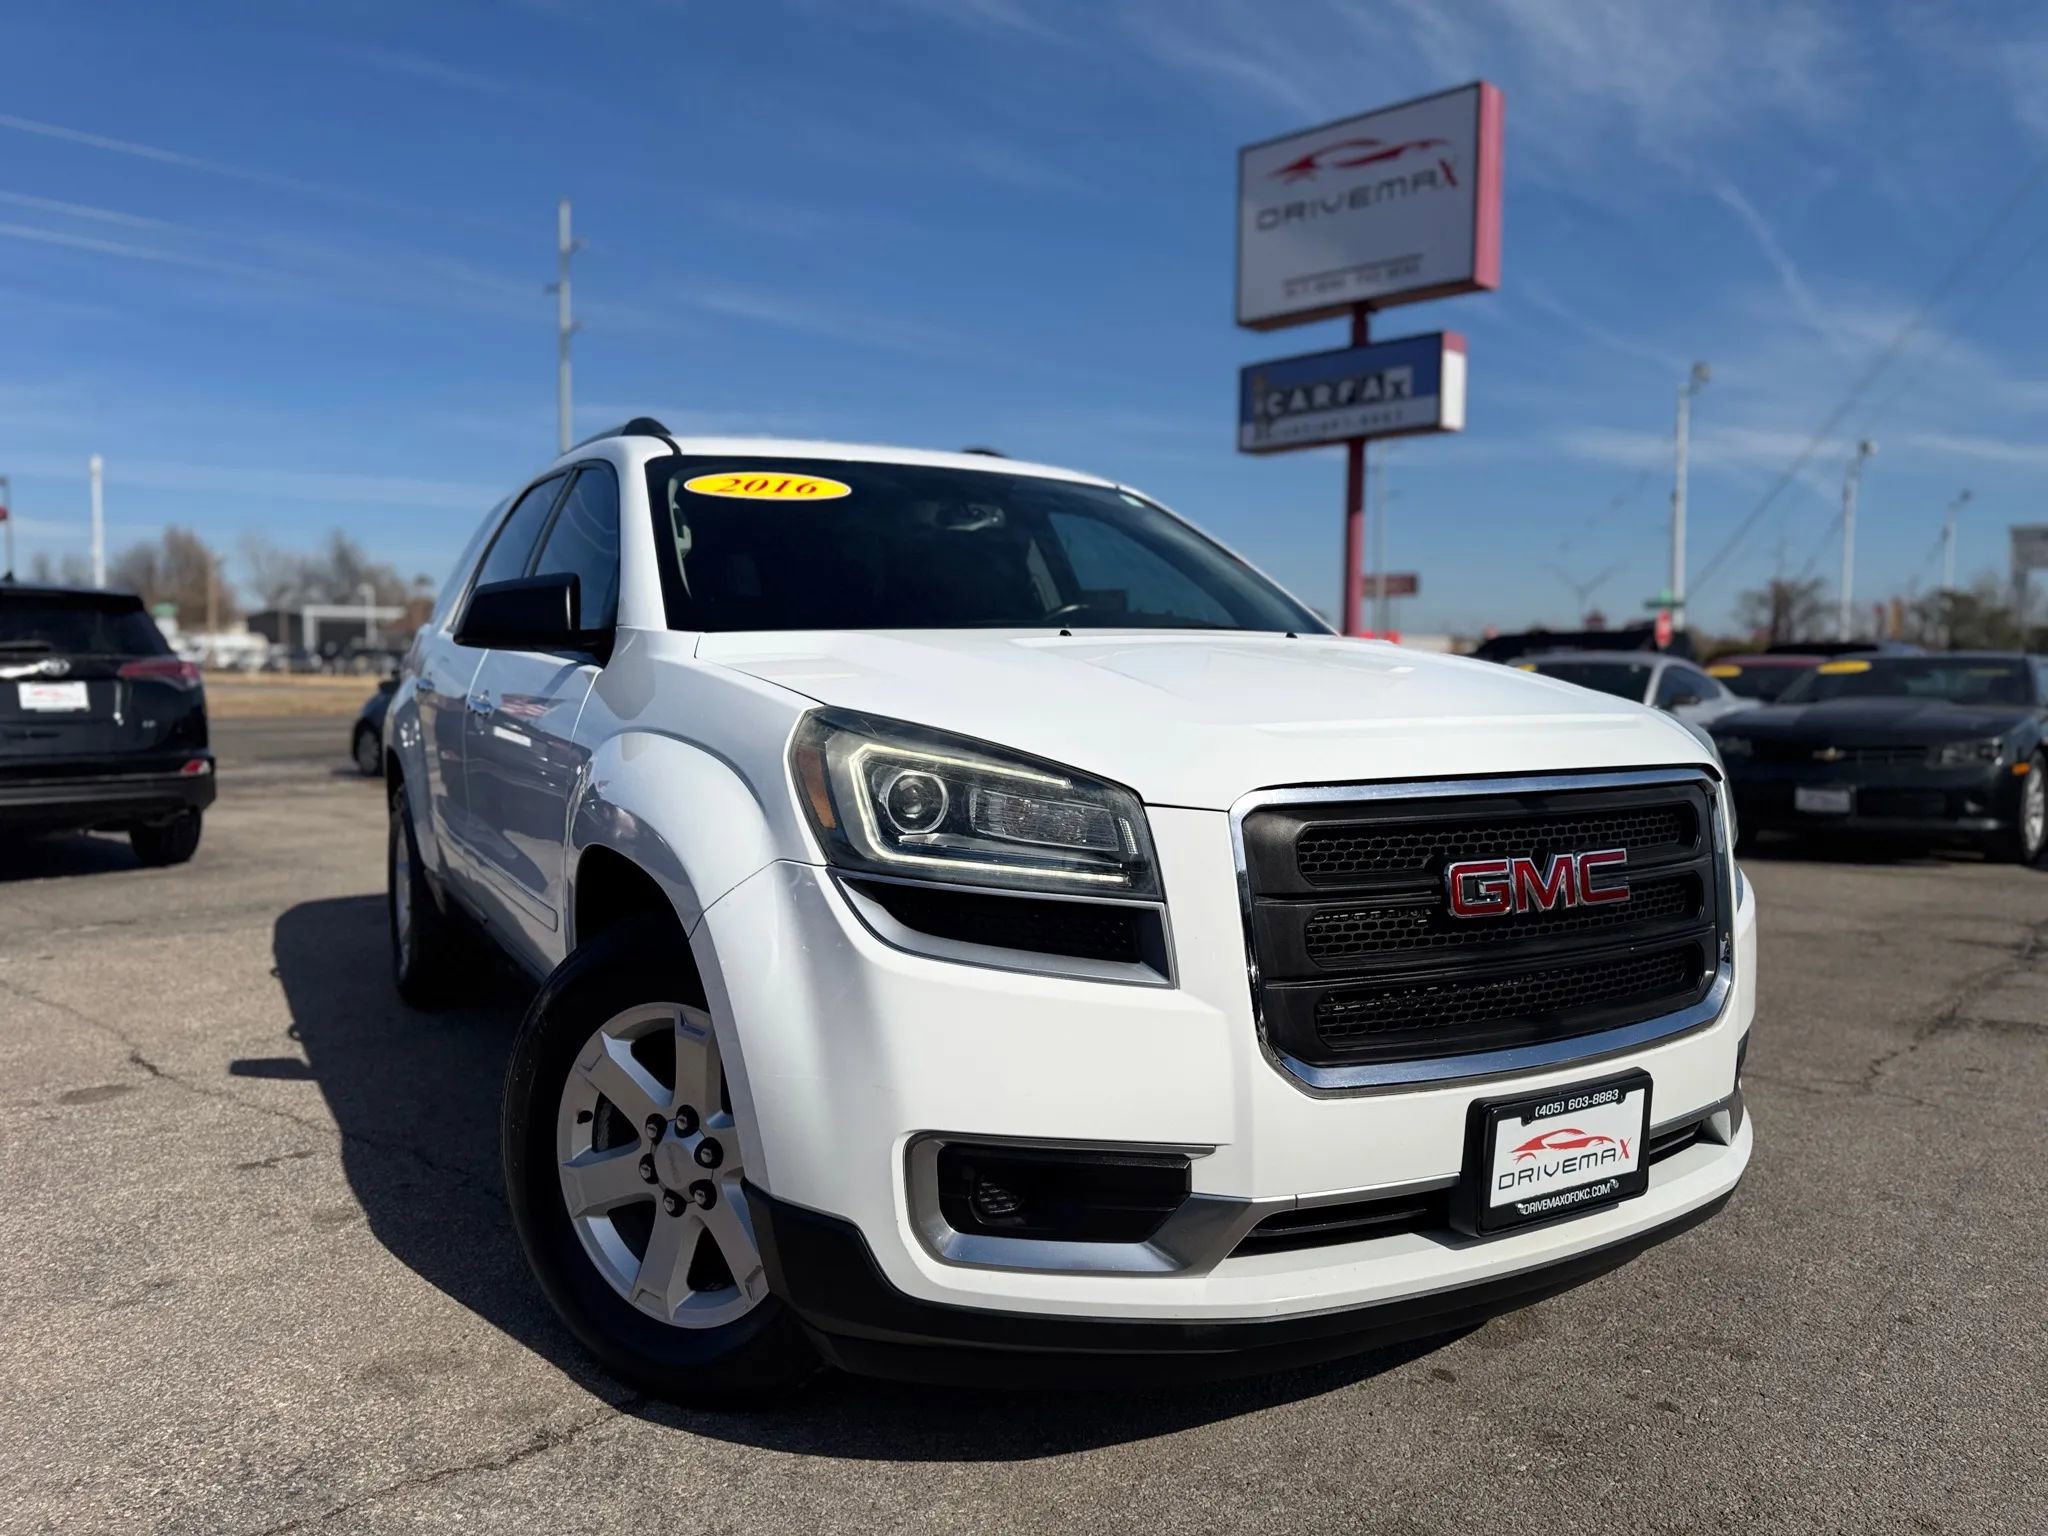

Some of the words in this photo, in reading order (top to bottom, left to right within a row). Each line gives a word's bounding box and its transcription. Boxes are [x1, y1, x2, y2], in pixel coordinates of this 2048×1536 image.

[1256, 158, 1458, 231] DRIVEMAX
[715, 478, 819, 494] 2016
[1448, 848, 1630, 918] GMC
[1535, 1101, 1565, 1118] (405)
[1568, 1089, 1619, 1110] 603-8883
[1498, 1137, 1632, 1190] DRIVEMAX
[1523, 1184, 1610, 1215] DRIVEMAXOFOKC.COM
